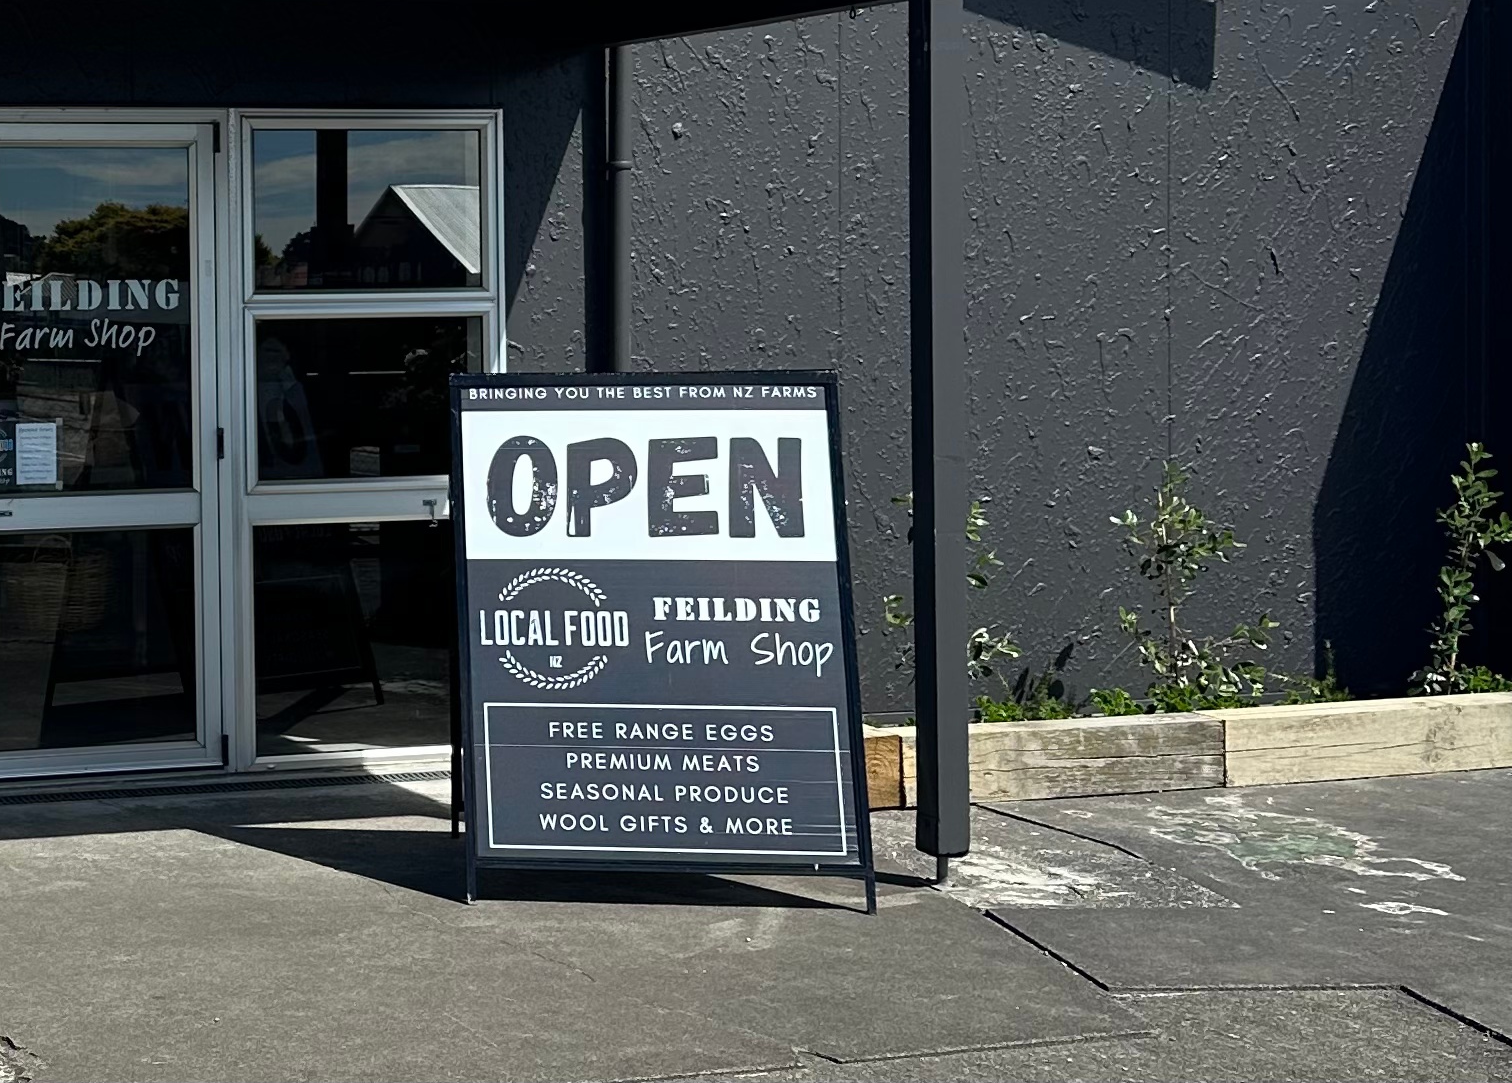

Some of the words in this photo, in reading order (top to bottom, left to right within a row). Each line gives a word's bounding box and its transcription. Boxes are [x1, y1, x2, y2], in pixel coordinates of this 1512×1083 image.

[0, 321, 73, 351] Farm
[83, 318, 156, 356] Shop
[468, 387, 547, 400] BRINGING
[554, 387, 590, 399] YOU
[596, 386, 625, 399] THE
[632, 386, 672, 399] BEST
[679, 386, 726, 399] FROM
[732, 386, 754, 399] NZ
[761, 386, 818, 399] FARMS
[486, 435, 805, 538] OPEN
[652, 596, 821, 623] FEILDING
[479, 609, 559, 646] LOCAL
[564, 609, 630, 647] FOOD
[549, 655, 563, 668] NZ
[644, 630, 729, 665] Farm
[749, 631, 834, 678] Shop
[548, 721, 604, 739] FREE
[615, 722, 694, 740] RANGE
[705, 723, 775, 742] EGGS
[566, 752, 672, 771] PREMIUM
[682, 754, 760, 773] MEATS
[540, 782, 664, 802] SEASONAL
[675, 784, 789, 804] PRODUCE
[539, 813, 609, 832] WOOL
[619, 814, 688, 833] GIFTS
[699, 816, 715, 834] &
[725, 816, 793, 835] MORE
